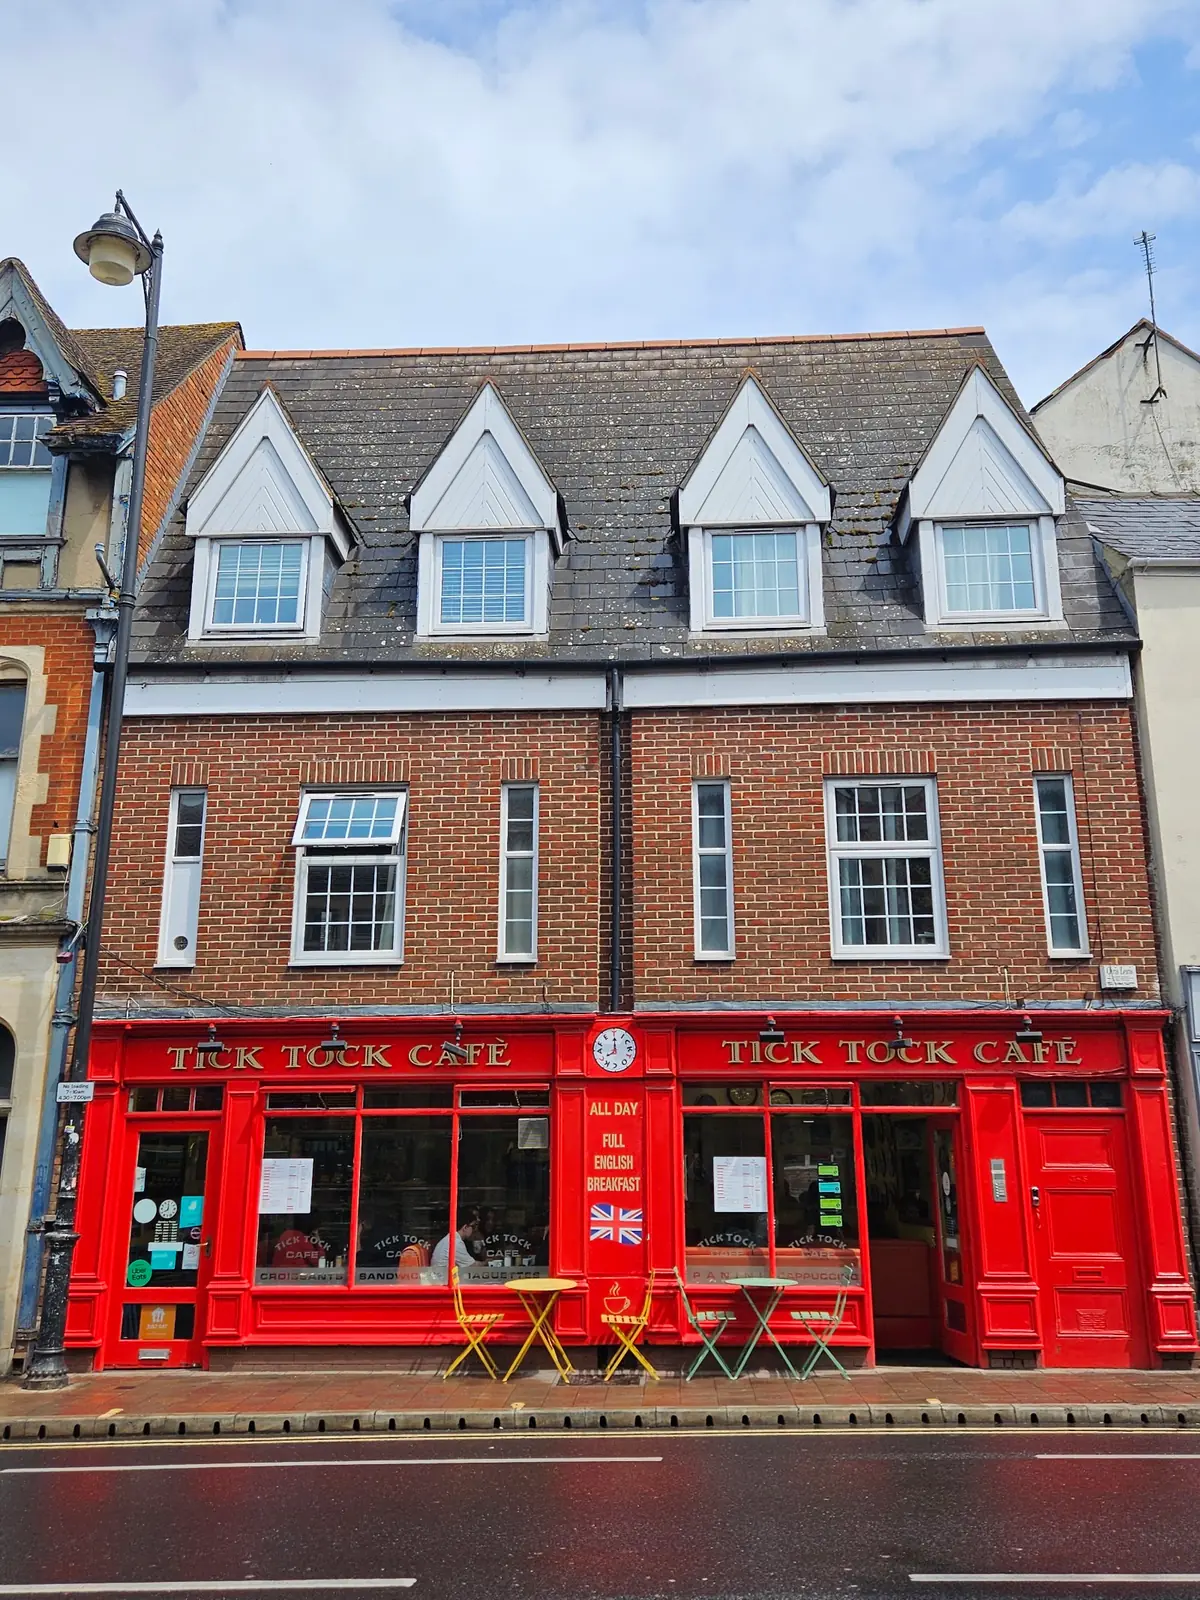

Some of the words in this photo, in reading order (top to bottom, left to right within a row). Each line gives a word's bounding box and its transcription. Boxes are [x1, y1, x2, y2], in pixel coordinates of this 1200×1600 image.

[167, 1046, 264, 1070] TICK
[281, 1045, 393, 1068] TOCK
[722, 1040, 823, 1064] TICK
[839, 1040, 958, 1064] TOCK
[589, 1102, 612, 1116] ALL
[614, 1102, 638, 1116] DAY
[602, 1133, 625, 1148] FULL
[594, 1155, 633, 1170] ENGLISH
[587, 1176, 641, 1192] BREAKFAST
[274, 1235, 300, 1251] TICK
[303, 1235, 332, 1251] TOCK
[374, 1235, 400, 1251] TICK
[403, 1234, 432, 1250] TOCK
[481, 1234, 500, 1247] ICK
[503, 1233, 532, 1250] TOCK
[697, 1233, 724, 1248] TICK
[725, 1233, 757, 1250] TOCK
[788, 1234, 814, 1249] TICK
[817, 1234, 848, 1250] TOCK
[286, 1250, 319, 1259] CAFE
[486, 1249, 520, 1257] CAFE
[260, 1272, 344, 1281] CROISSANTS
